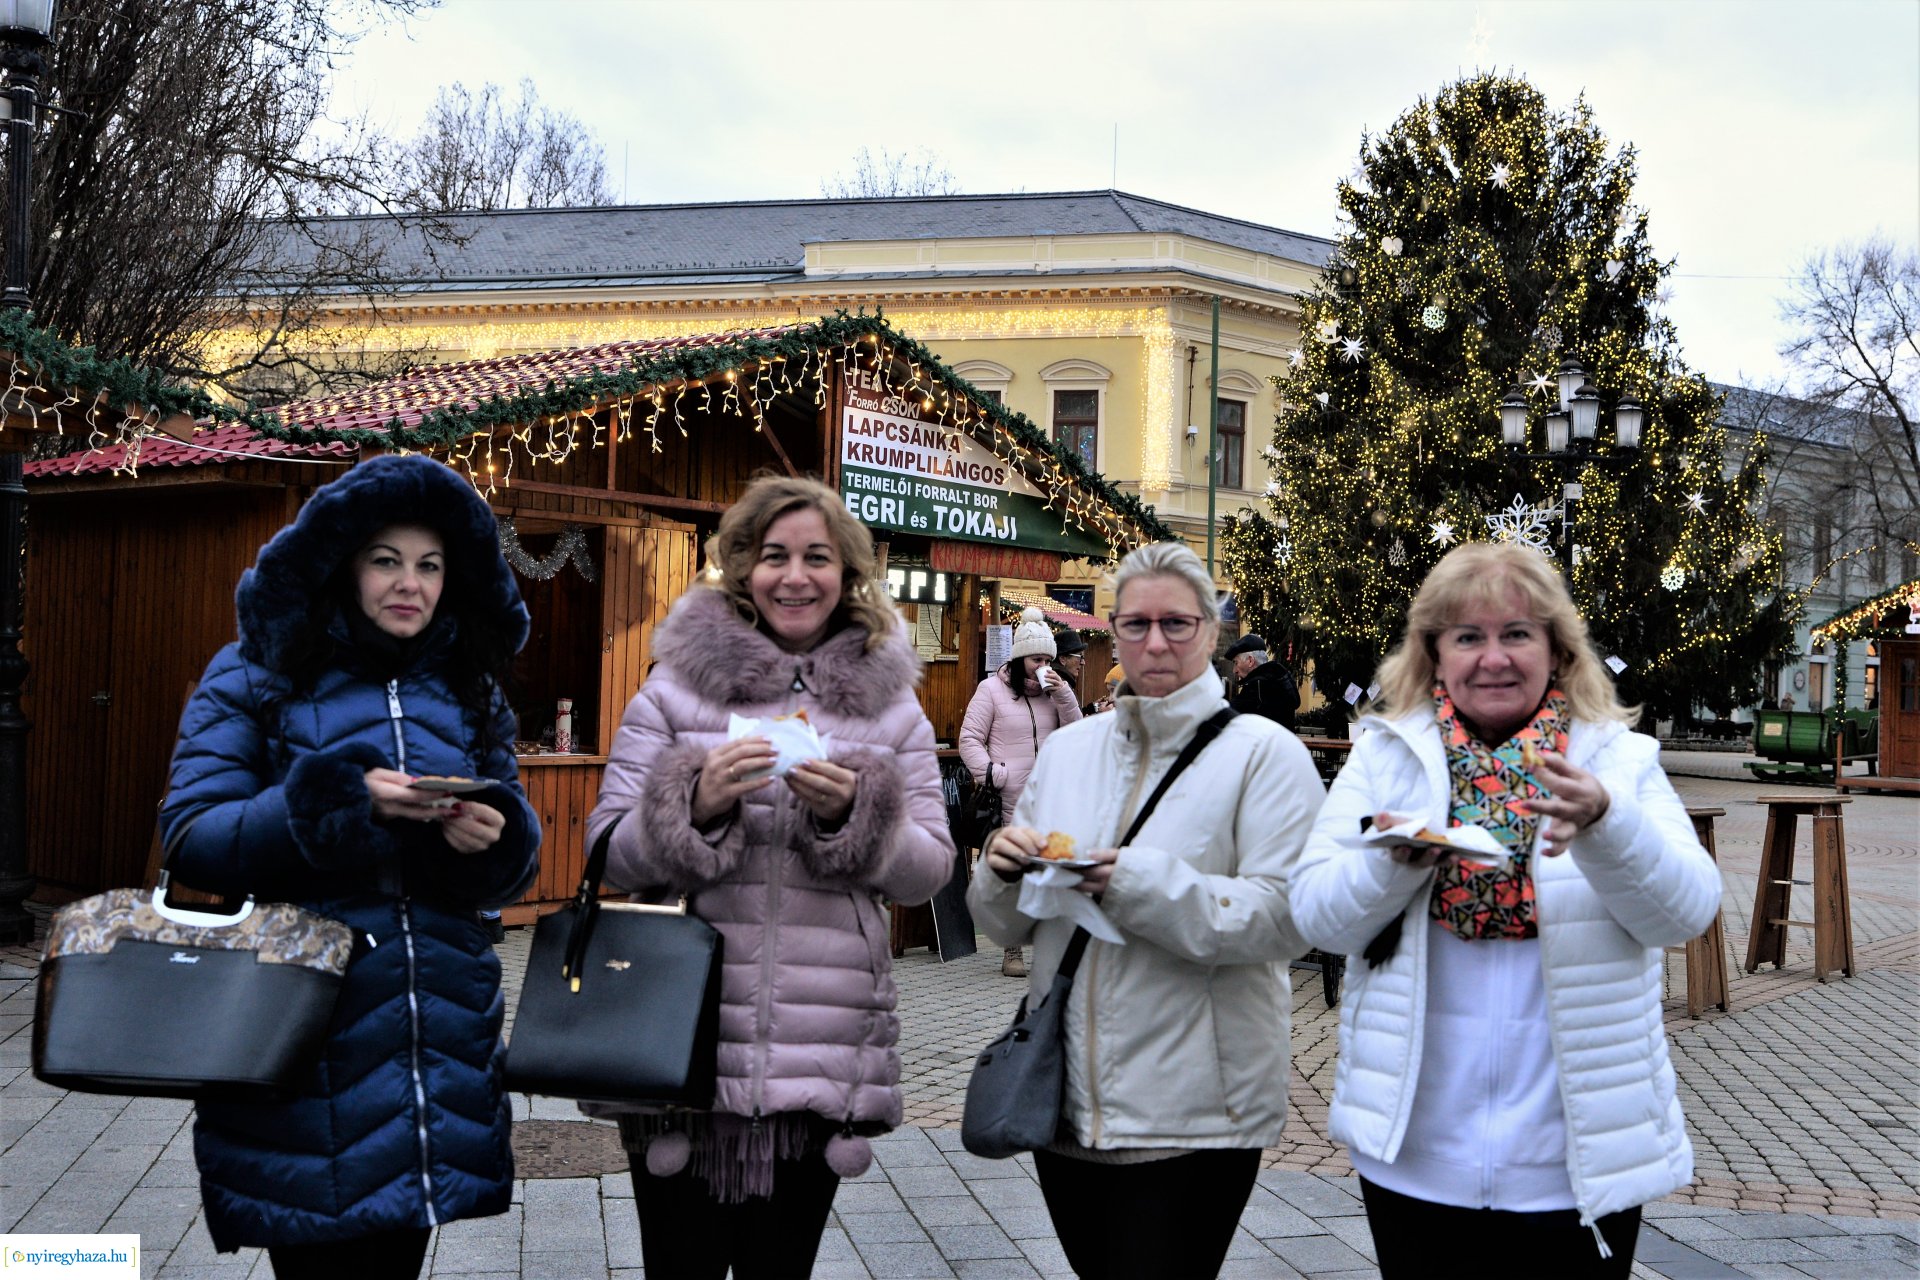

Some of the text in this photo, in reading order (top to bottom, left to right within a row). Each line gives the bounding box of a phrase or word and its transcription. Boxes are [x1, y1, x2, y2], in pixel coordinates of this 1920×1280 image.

[849, 367, 883, 392] TEA
[848, 389, 921, 419] FORRÓ CSOKI
[848, 414, 961, 453] LAPCSÁNKA
[847, 441, 1004, 485] KRUMPLILÁNGOS
[845, 471, 998, 510] TERMELŐI FORRALT BOR
[845, 492, 1017, 541] EGRI és TOKAJI
